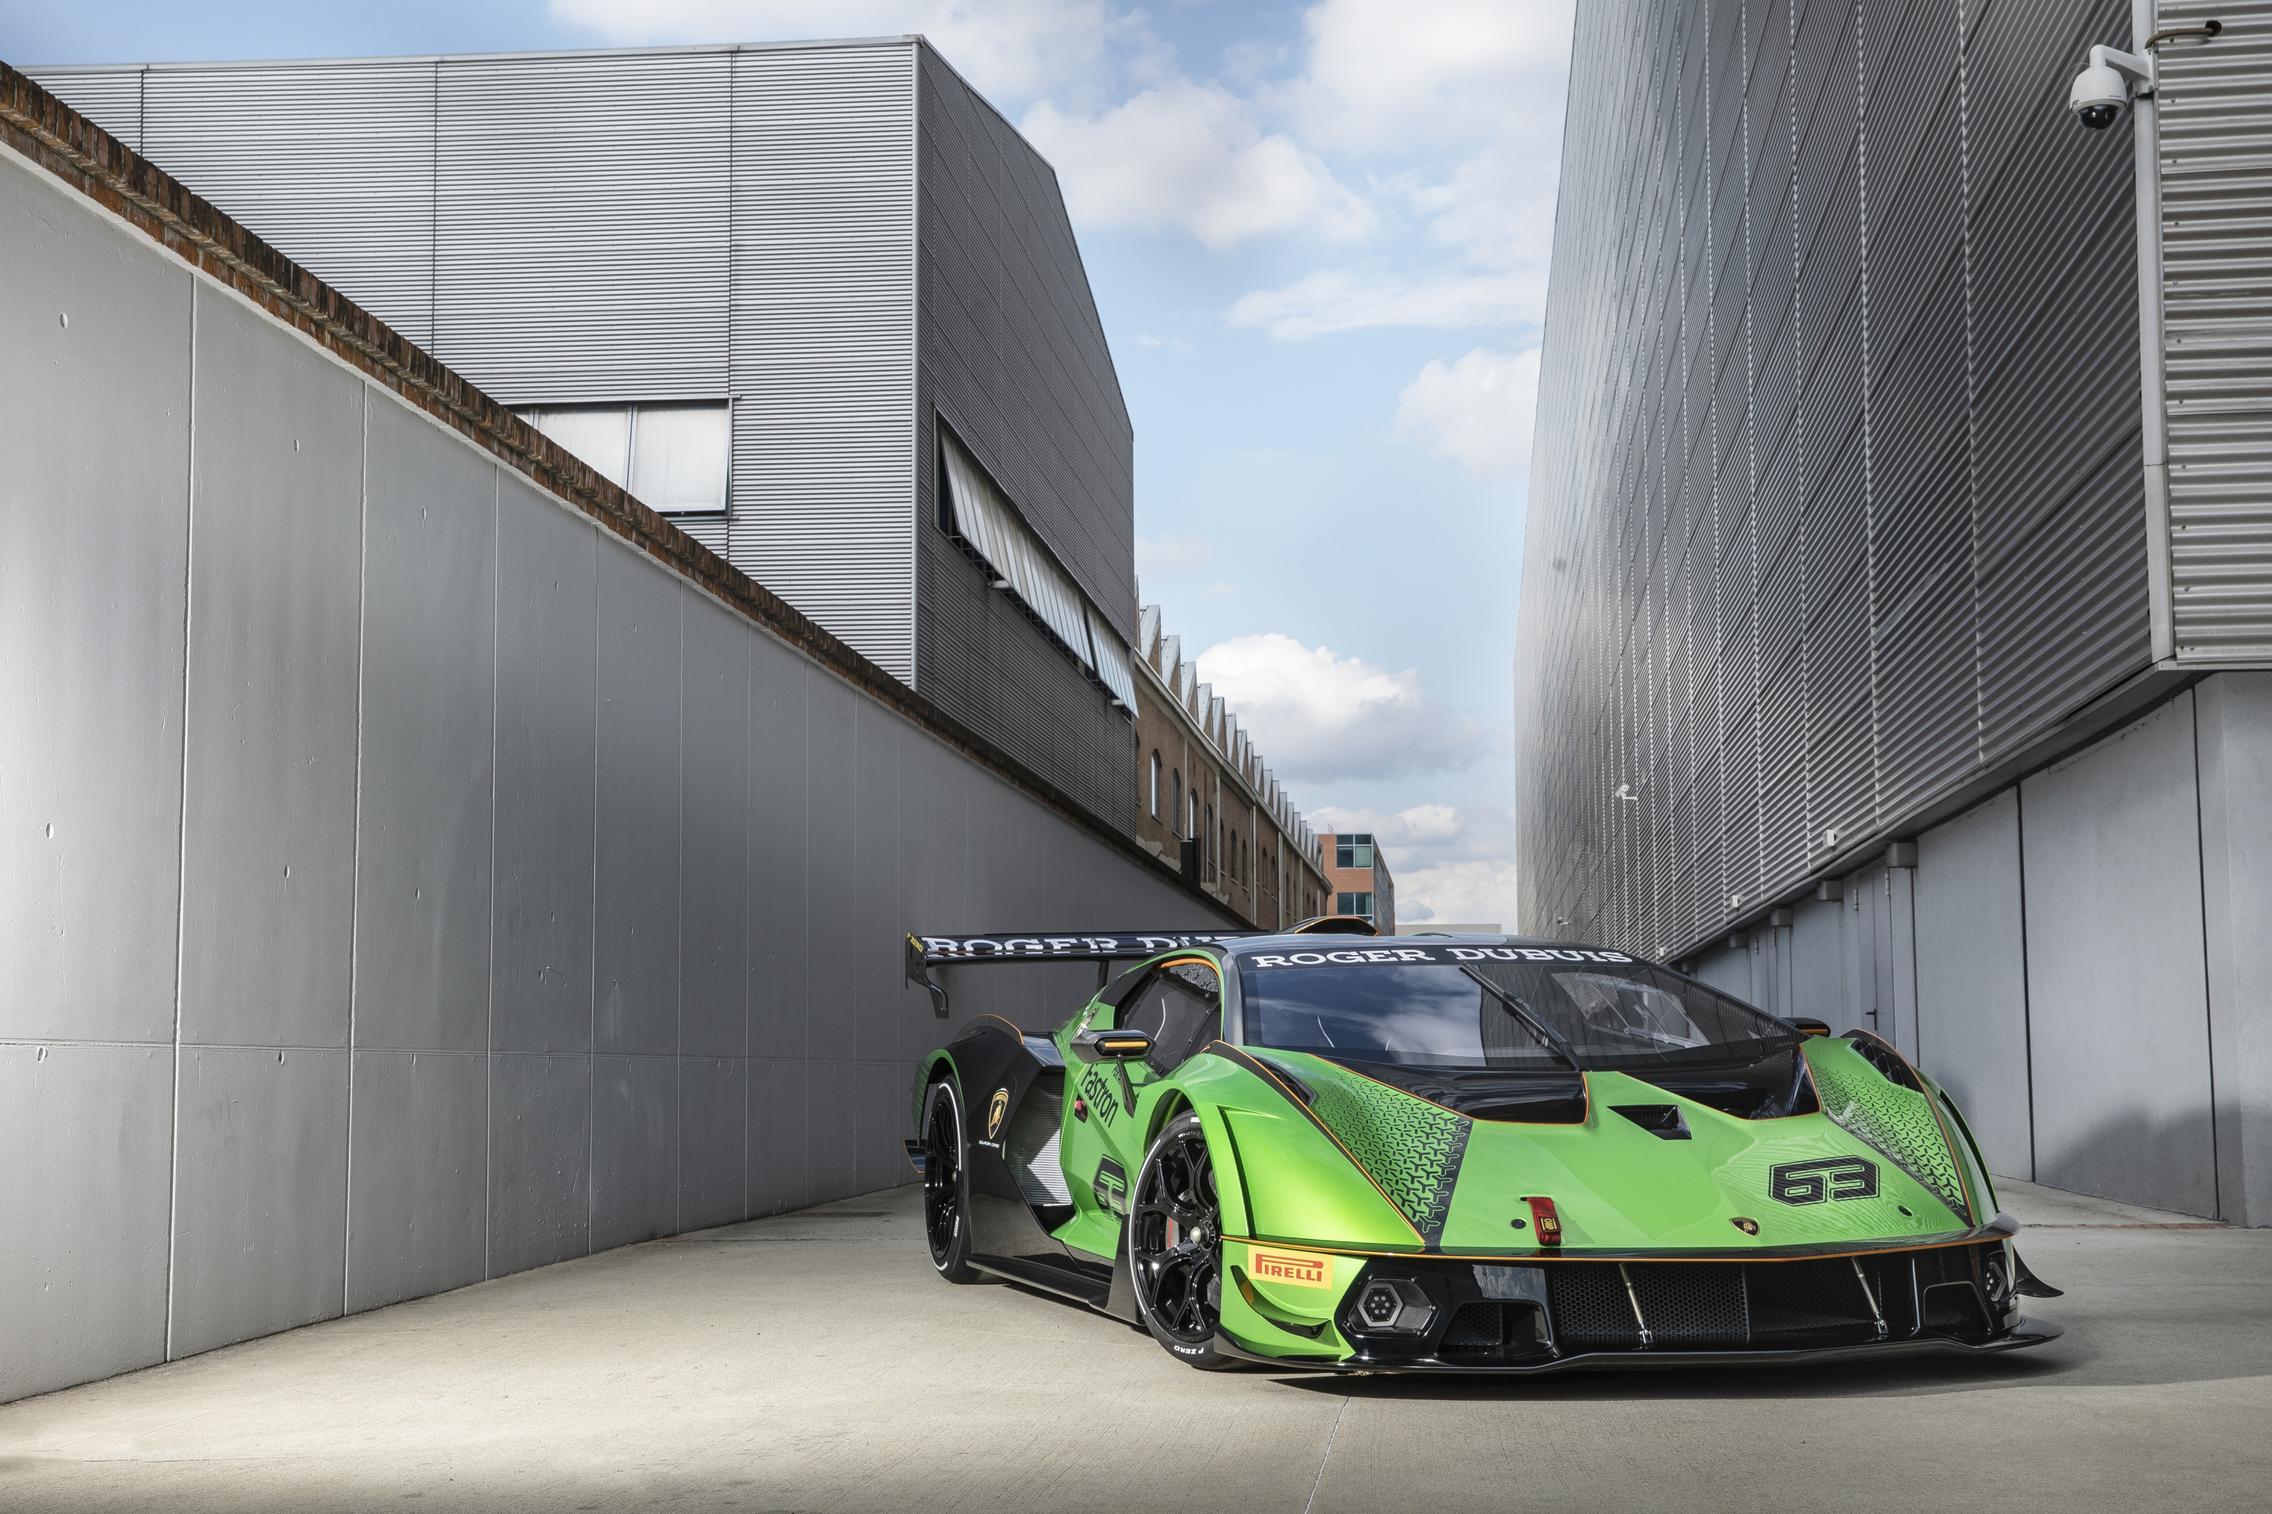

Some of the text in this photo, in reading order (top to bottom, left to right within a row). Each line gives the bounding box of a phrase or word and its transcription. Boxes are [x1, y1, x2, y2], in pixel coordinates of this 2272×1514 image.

[921, 936, 1118, 958] ROGER
[1255, 948, 1634, 968] ROGER DUBUIS
[1080, 1063, 1119, 1128] Fastron
[1768, 1155, 1881, 1207] 63
[1255, 1253, 1324, 1282] PIRELLI
